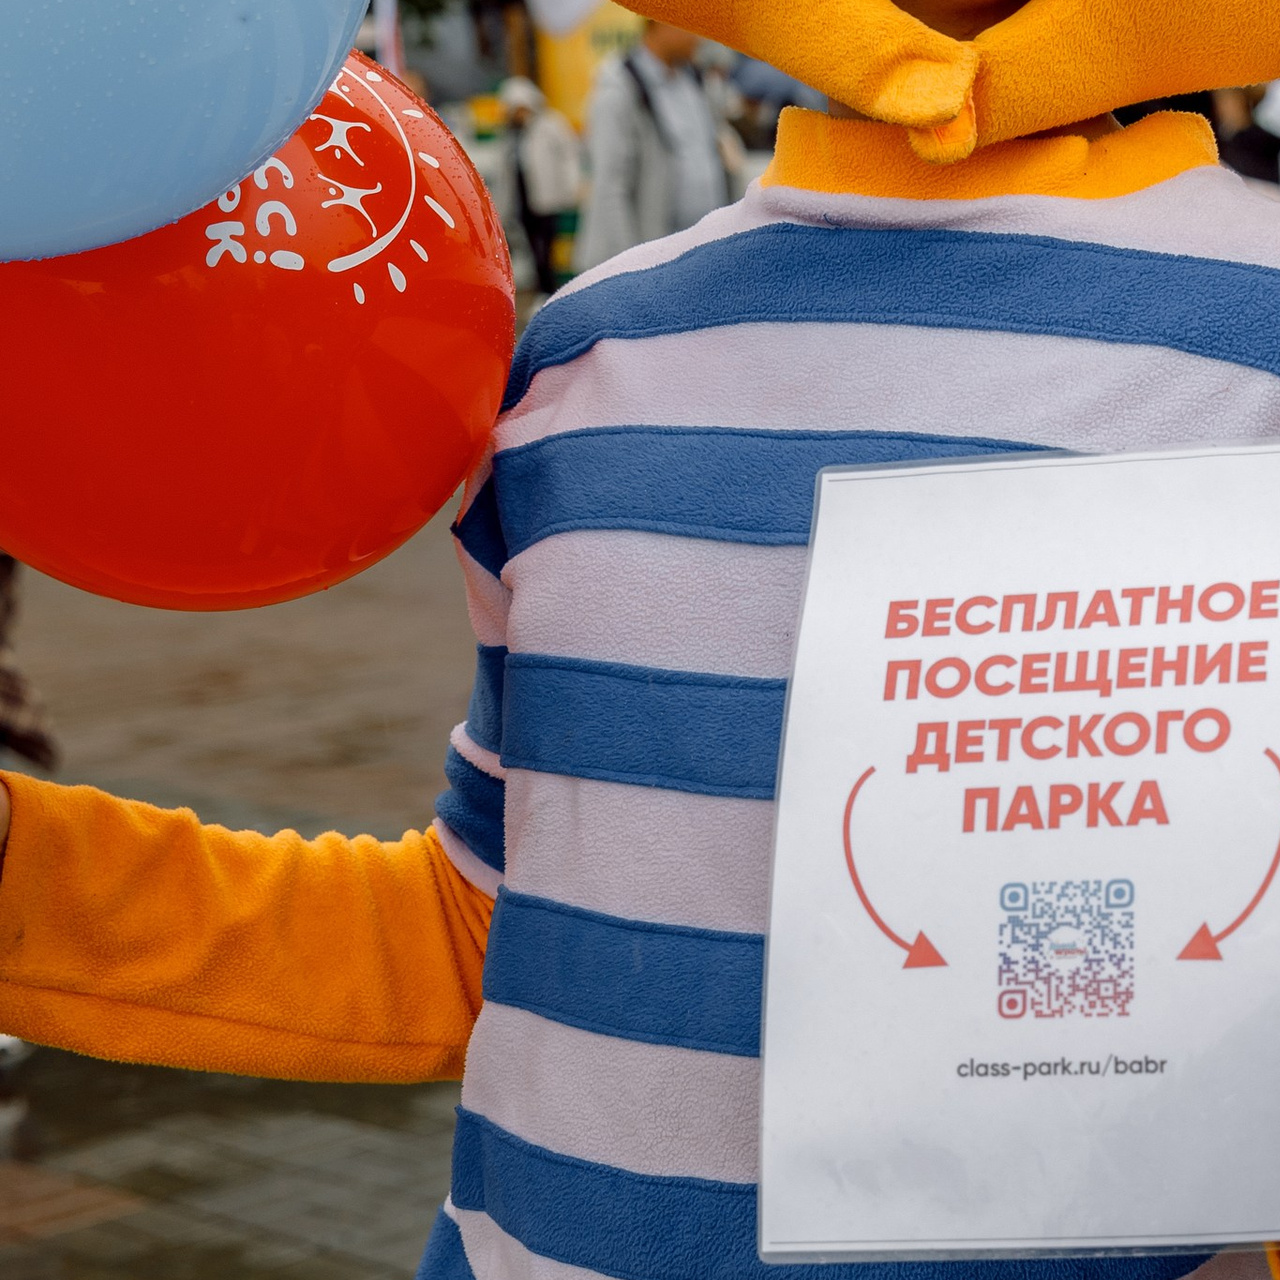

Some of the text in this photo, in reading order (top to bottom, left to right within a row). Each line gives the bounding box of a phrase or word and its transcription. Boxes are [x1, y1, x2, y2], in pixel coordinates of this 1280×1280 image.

[884, 580, 1280, 639] БЕСПЛАТНОЕ
[883, 640, 1268, 701] ПОСЕЩЕНИЕ
[906, 707, 1231, 774] ДЕТСКОГО
[962, 780, 1169, 833] ПАРКА
[956, 1053, 1168, 1081] class-park.ru/babr
